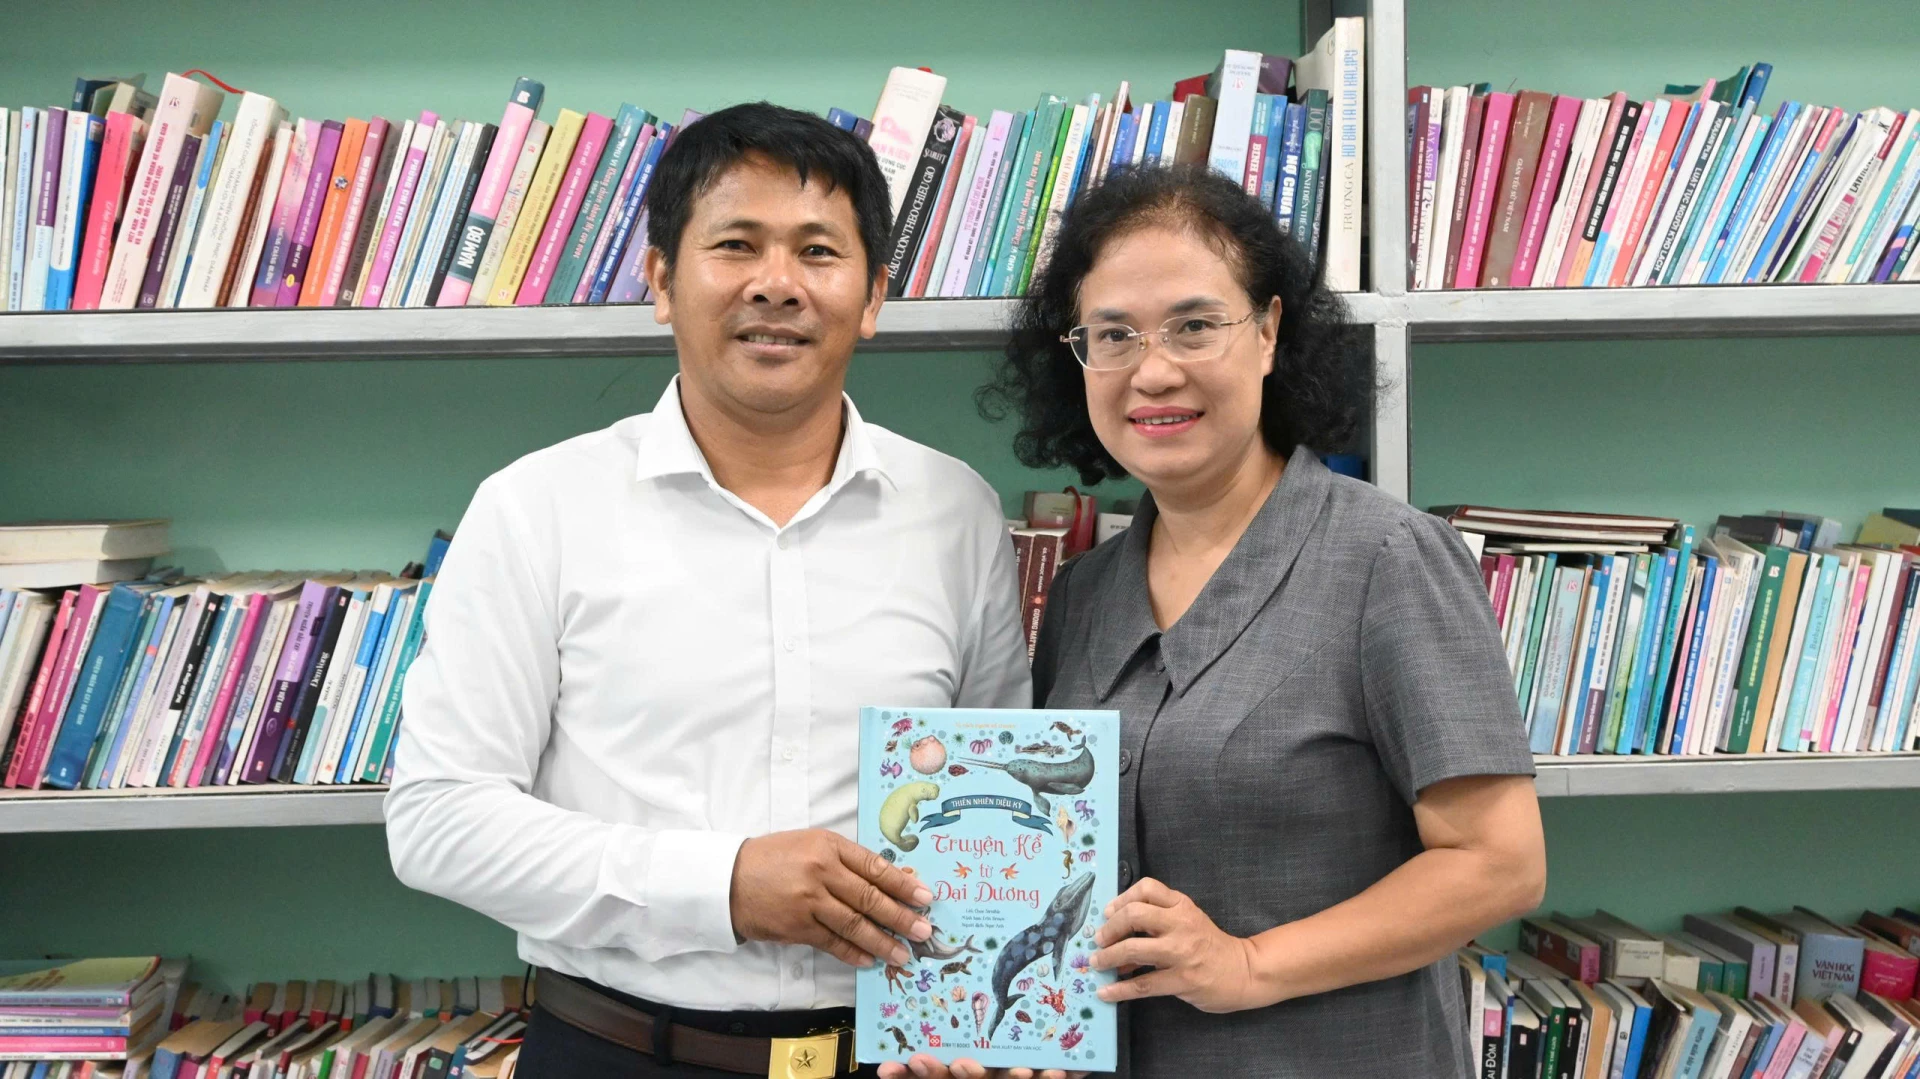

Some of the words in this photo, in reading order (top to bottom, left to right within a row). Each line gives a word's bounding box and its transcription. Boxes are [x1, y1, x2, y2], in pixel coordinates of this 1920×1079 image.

[1426, 124, 1437, 144] JAY
[1421, 144, 1435, 179] ASHER
[951, 798, 972, 808] THIÊN
[973, 797, 994, 805] NHIÊN
[995, 798, 1011, 807] DIỆU
[930, 834, 1008, 860] Truyện
[1013, 833, 1043, 860] Kể
[980, 863, 994, 878] từ
[933, 880, 967, 902] Đại
[974, 881, 1040, 909] Dương
[973, 1037, 990, 1049] vh
